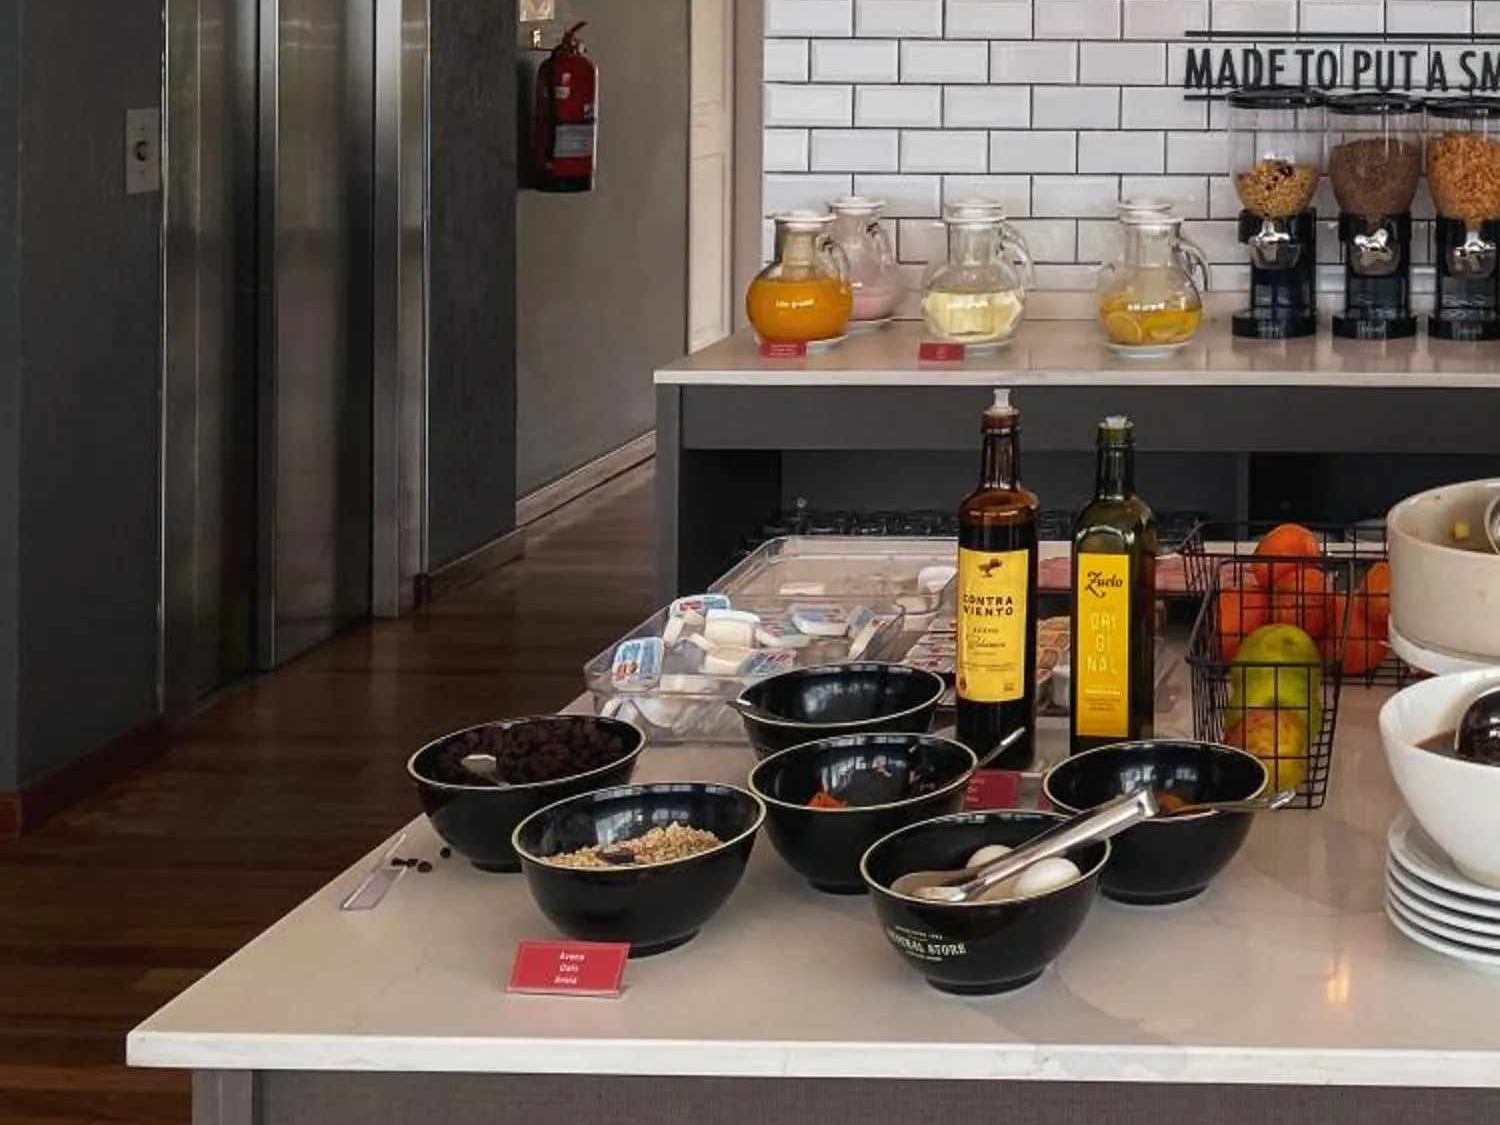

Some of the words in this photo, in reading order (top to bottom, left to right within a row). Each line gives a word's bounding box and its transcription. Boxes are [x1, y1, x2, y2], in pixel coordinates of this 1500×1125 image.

[1184, 48, 1286, 89] MADE
[1296, 49, 1338, 91] TO
[1352, 50, 1417, 92] PUT
[1425, 50, 1449, 92] A
[1084, 570, 1123, 599] Zuelo
[963, 594, 1014, 606] CONTRA
[963, 606, 1014, 617] VIENTO
